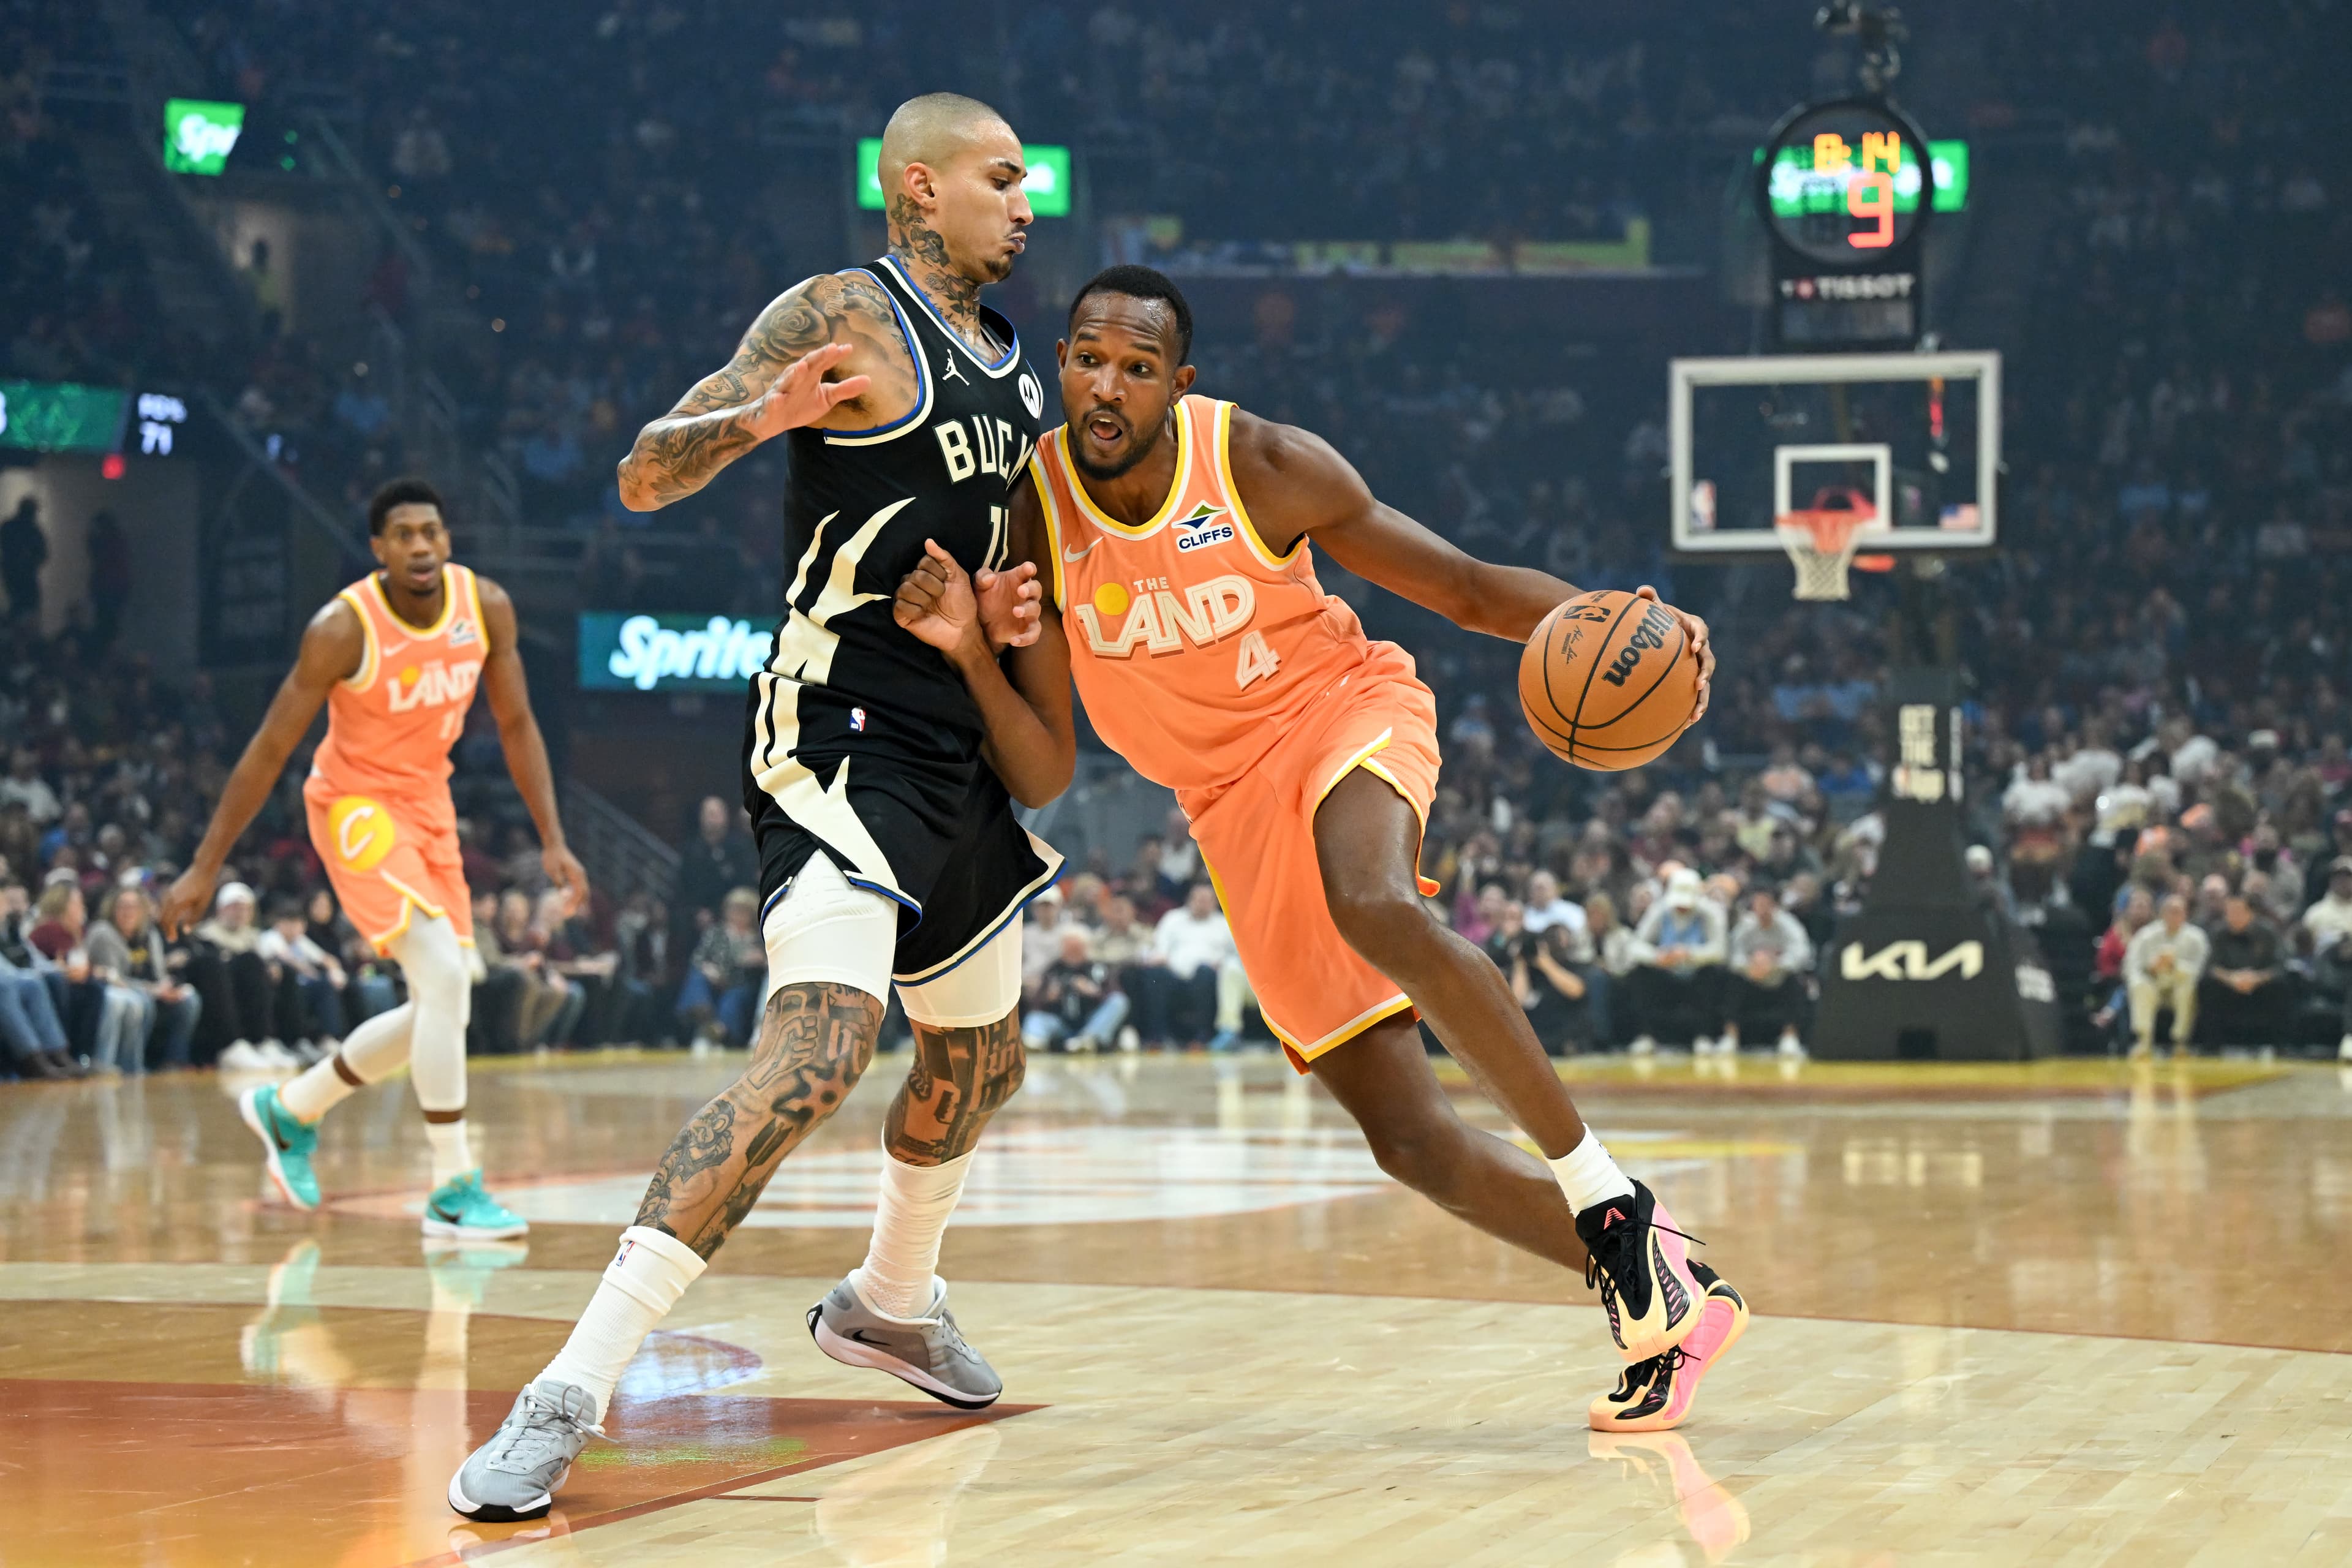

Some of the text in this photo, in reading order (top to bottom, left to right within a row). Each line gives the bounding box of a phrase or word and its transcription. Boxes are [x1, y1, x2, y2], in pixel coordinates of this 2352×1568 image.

[1847, 172, 1894, 248] 9
[1178, 526, 1233, 550] CLIFFS
[1133, 576, 1170, 594] THE
[1074, 575, 1256, 660] LAND
[1600, 603, 1675, 687] Wilson
[1234, 629, 1281, 692] 4
[339, 805, 375, 859] C
